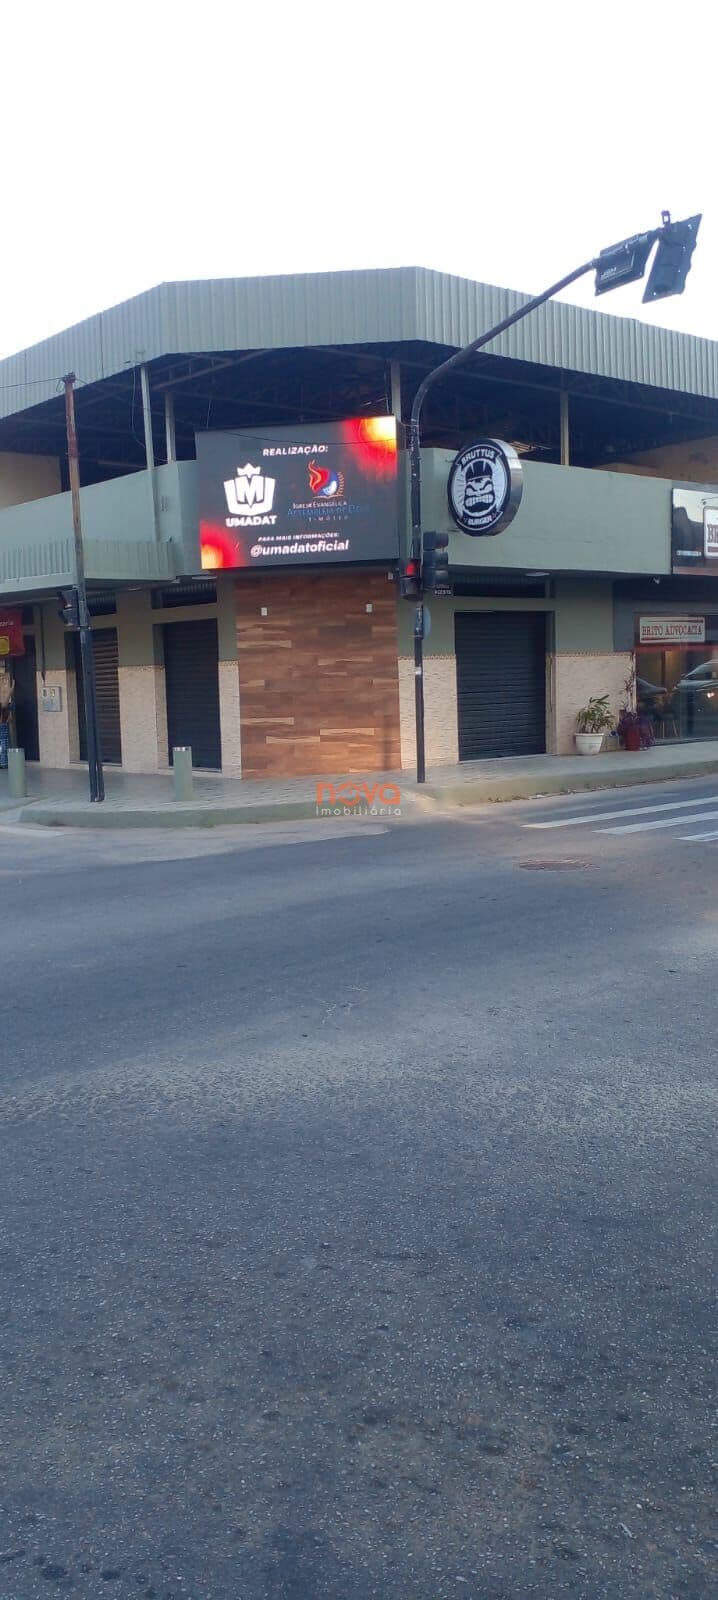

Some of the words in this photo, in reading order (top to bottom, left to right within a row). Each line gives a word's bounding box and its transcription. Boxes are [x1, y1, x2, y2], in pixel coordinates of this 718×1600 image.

[262, 444, 329, 457] REALIZAÇÃO:
[461, 448, 496, 465] BRUTTUS
[225, 515, 278, 528] UMADAT
[250, 539, 350, 558] @umadatoficial
[641, 625, 664, 637] BRITO
